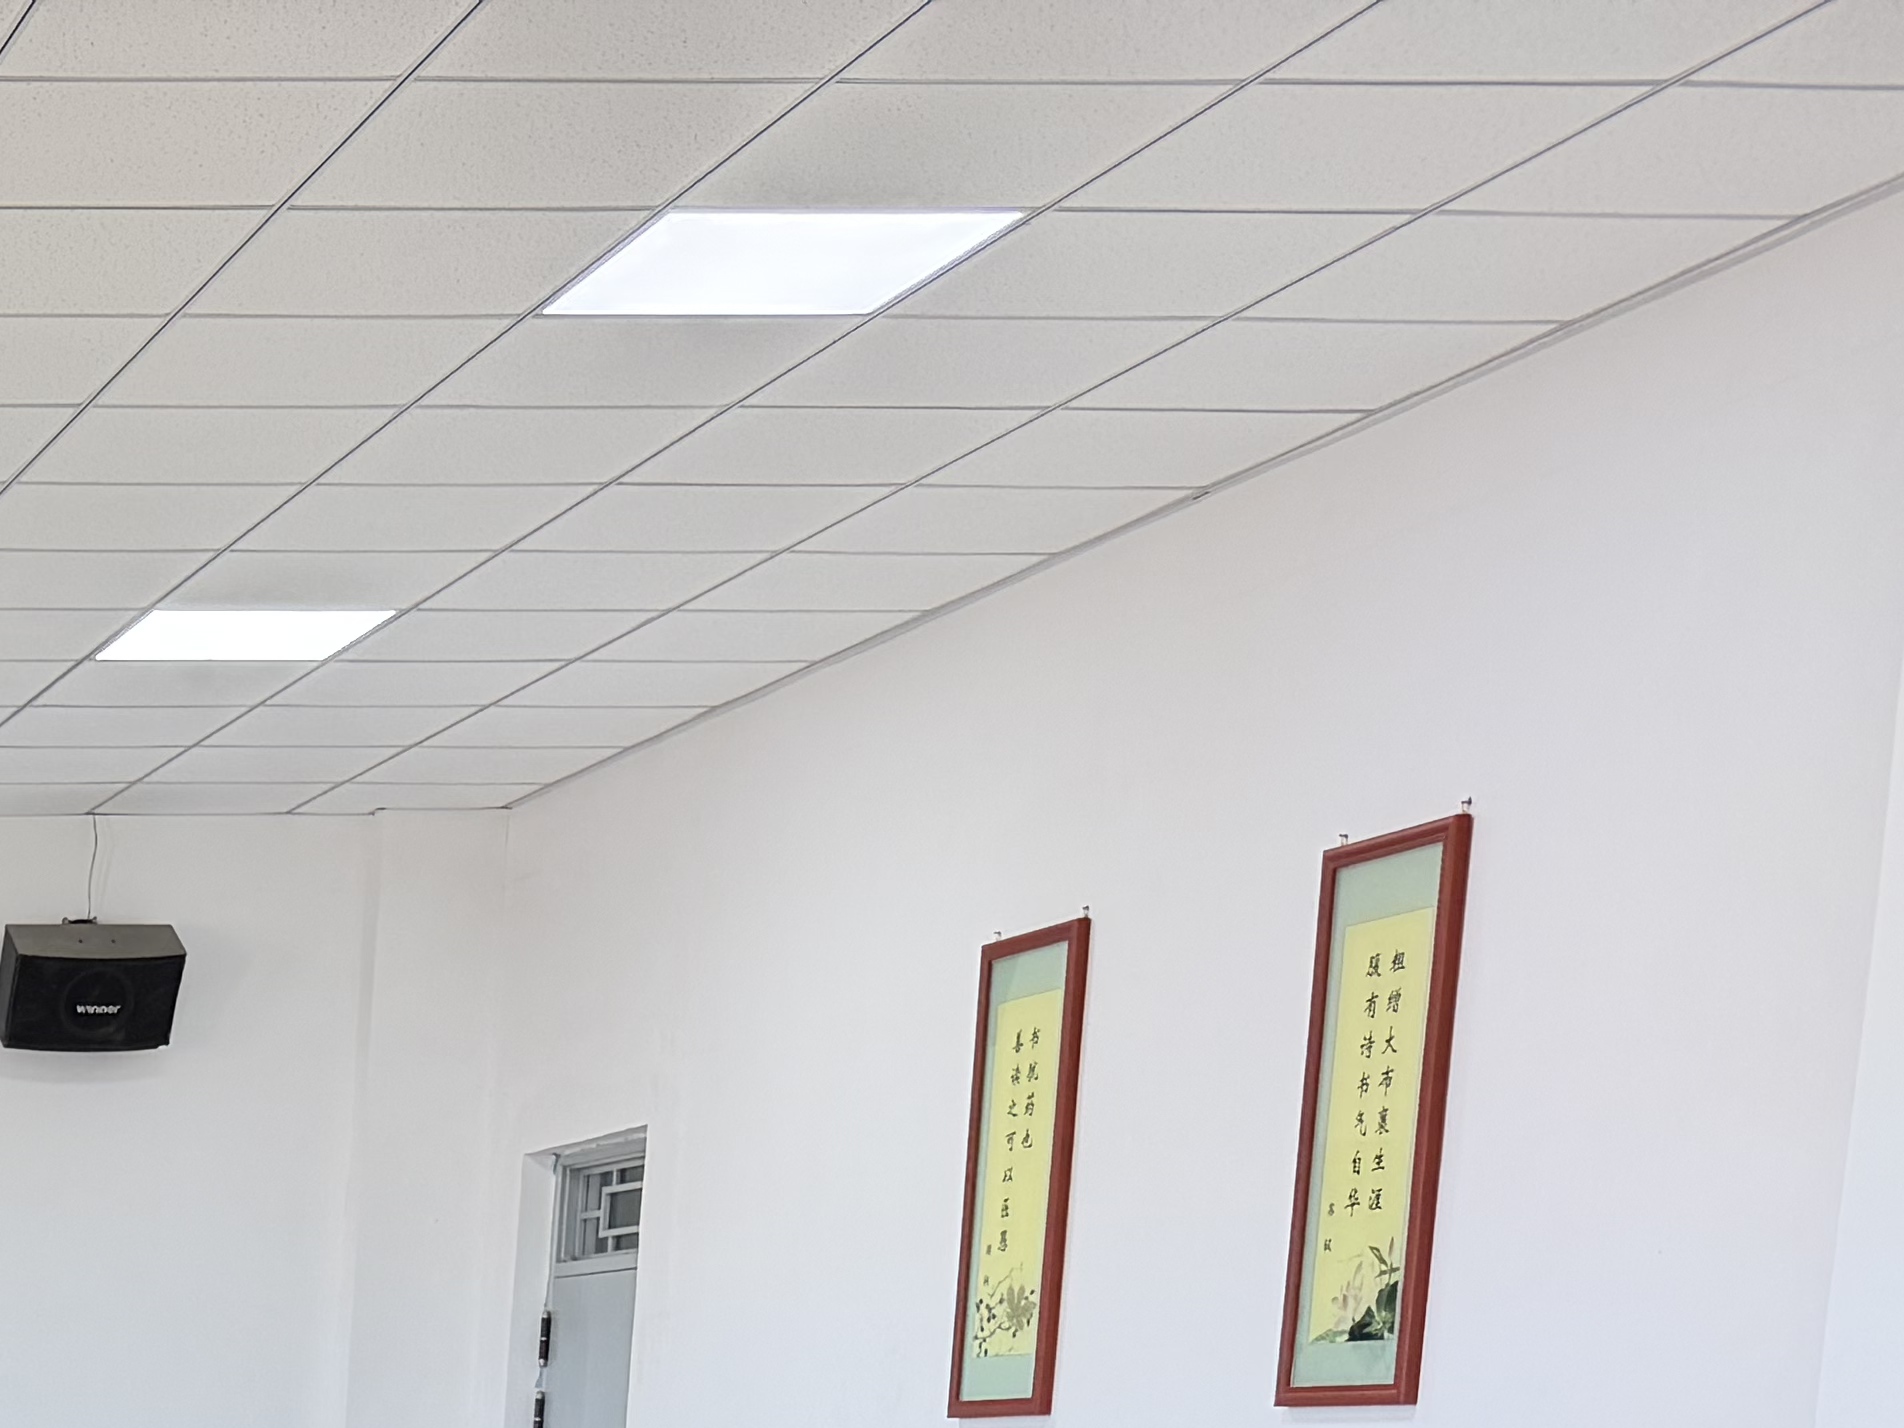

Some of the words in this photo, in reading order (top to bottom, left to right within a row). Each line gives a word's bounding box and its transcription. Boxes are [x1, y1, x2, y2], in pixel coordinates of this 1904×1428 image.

[1343, 953, 1382, 1218] 腹有诗书气自华
